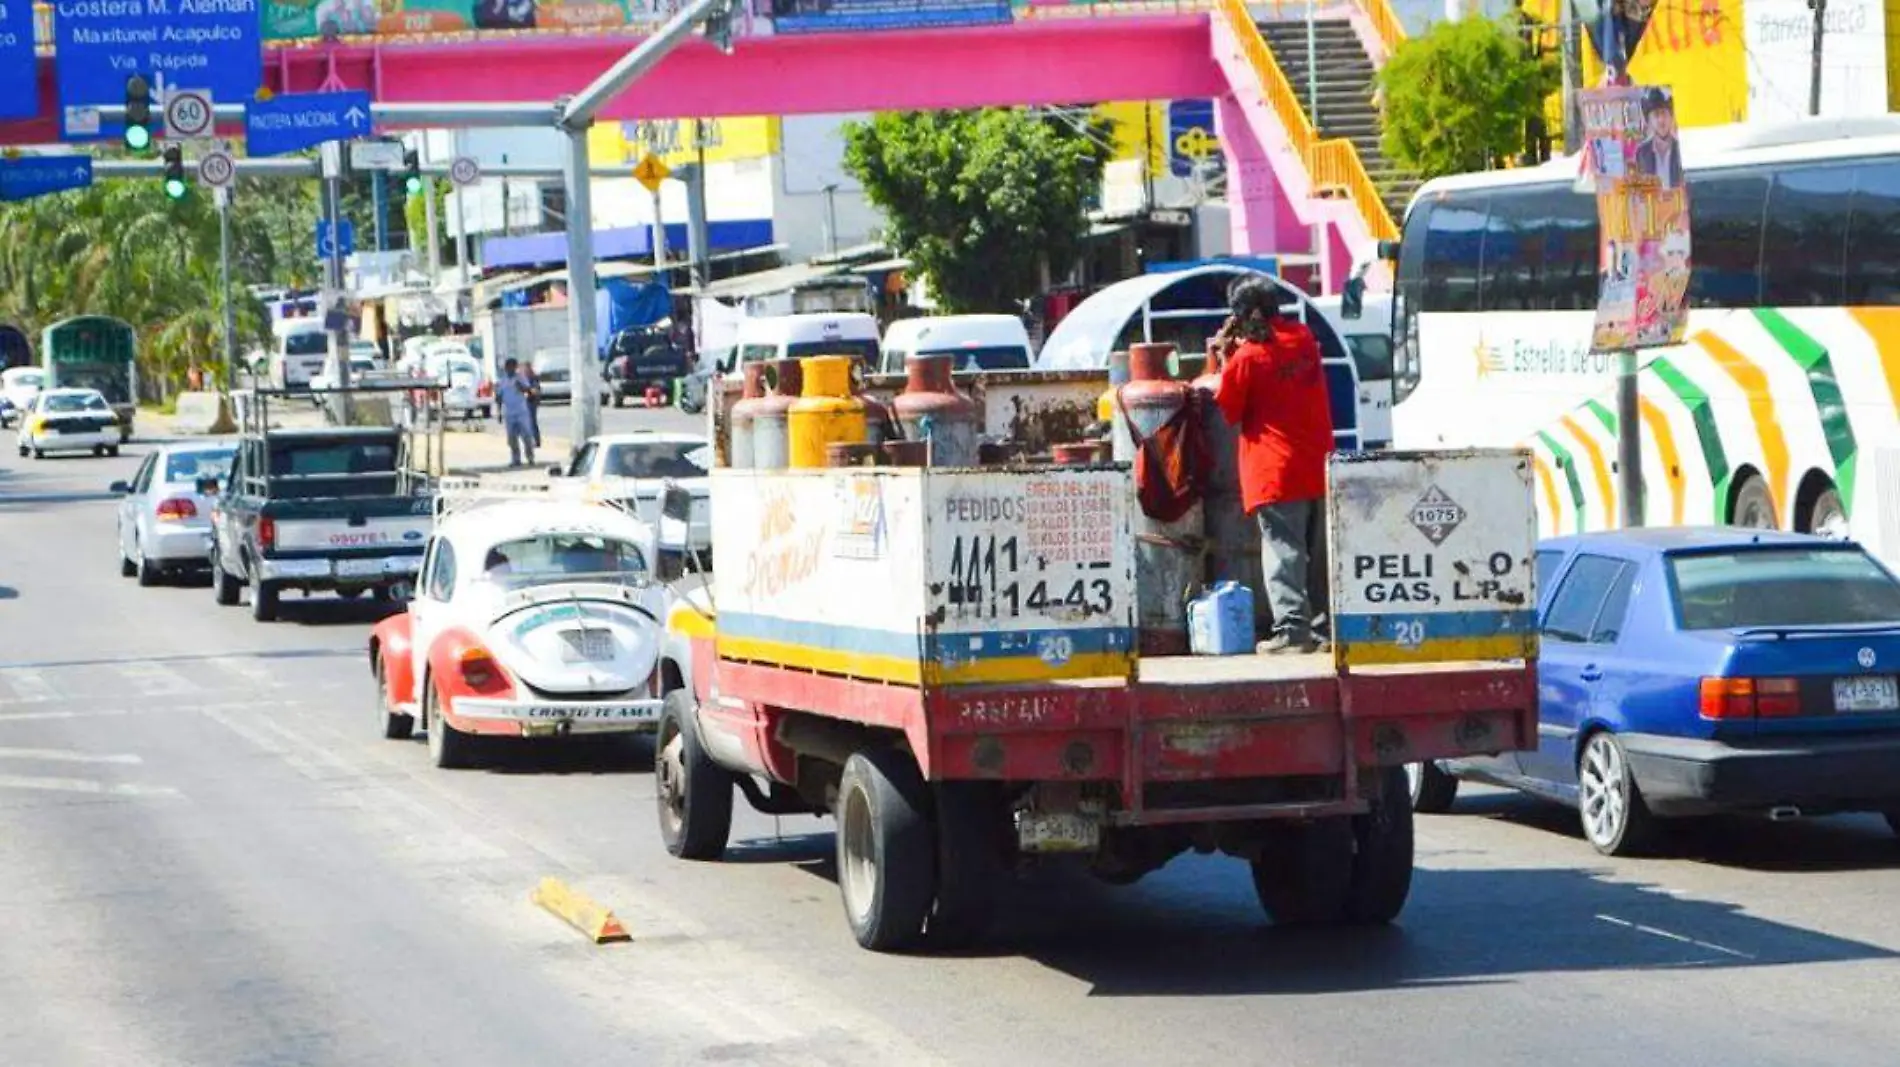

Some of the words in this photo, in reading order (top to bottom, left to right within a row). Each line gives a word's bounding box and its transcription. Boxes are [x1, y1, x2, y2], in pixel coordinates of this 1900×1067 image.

[58, 0, 143, 17] Costera
[149, 0, 170, 15] M.
[162, 24, 242, 42] Acapulco
[177, 101, 200, 121] 60
[1513, 338, 1566, 374] Estrella
[1571, 340, 1590, 374] de
[1593, 350, 1616, 374] Or
[946, 495, 1025, 523] PEDIDOS
[1417, 508, 1454, 522] 1075
[1431, 525, 1442, 538] 2
[1354, 552, 1513, 580] PELIO
[1364, 582, 1441, 605] GAS,
[1394, 621, 1425, 645] 20
[1041, 636, 1072, 661] 20
[595, 706, 611, 718] TE
[618, 706, 654, 718] AMA
